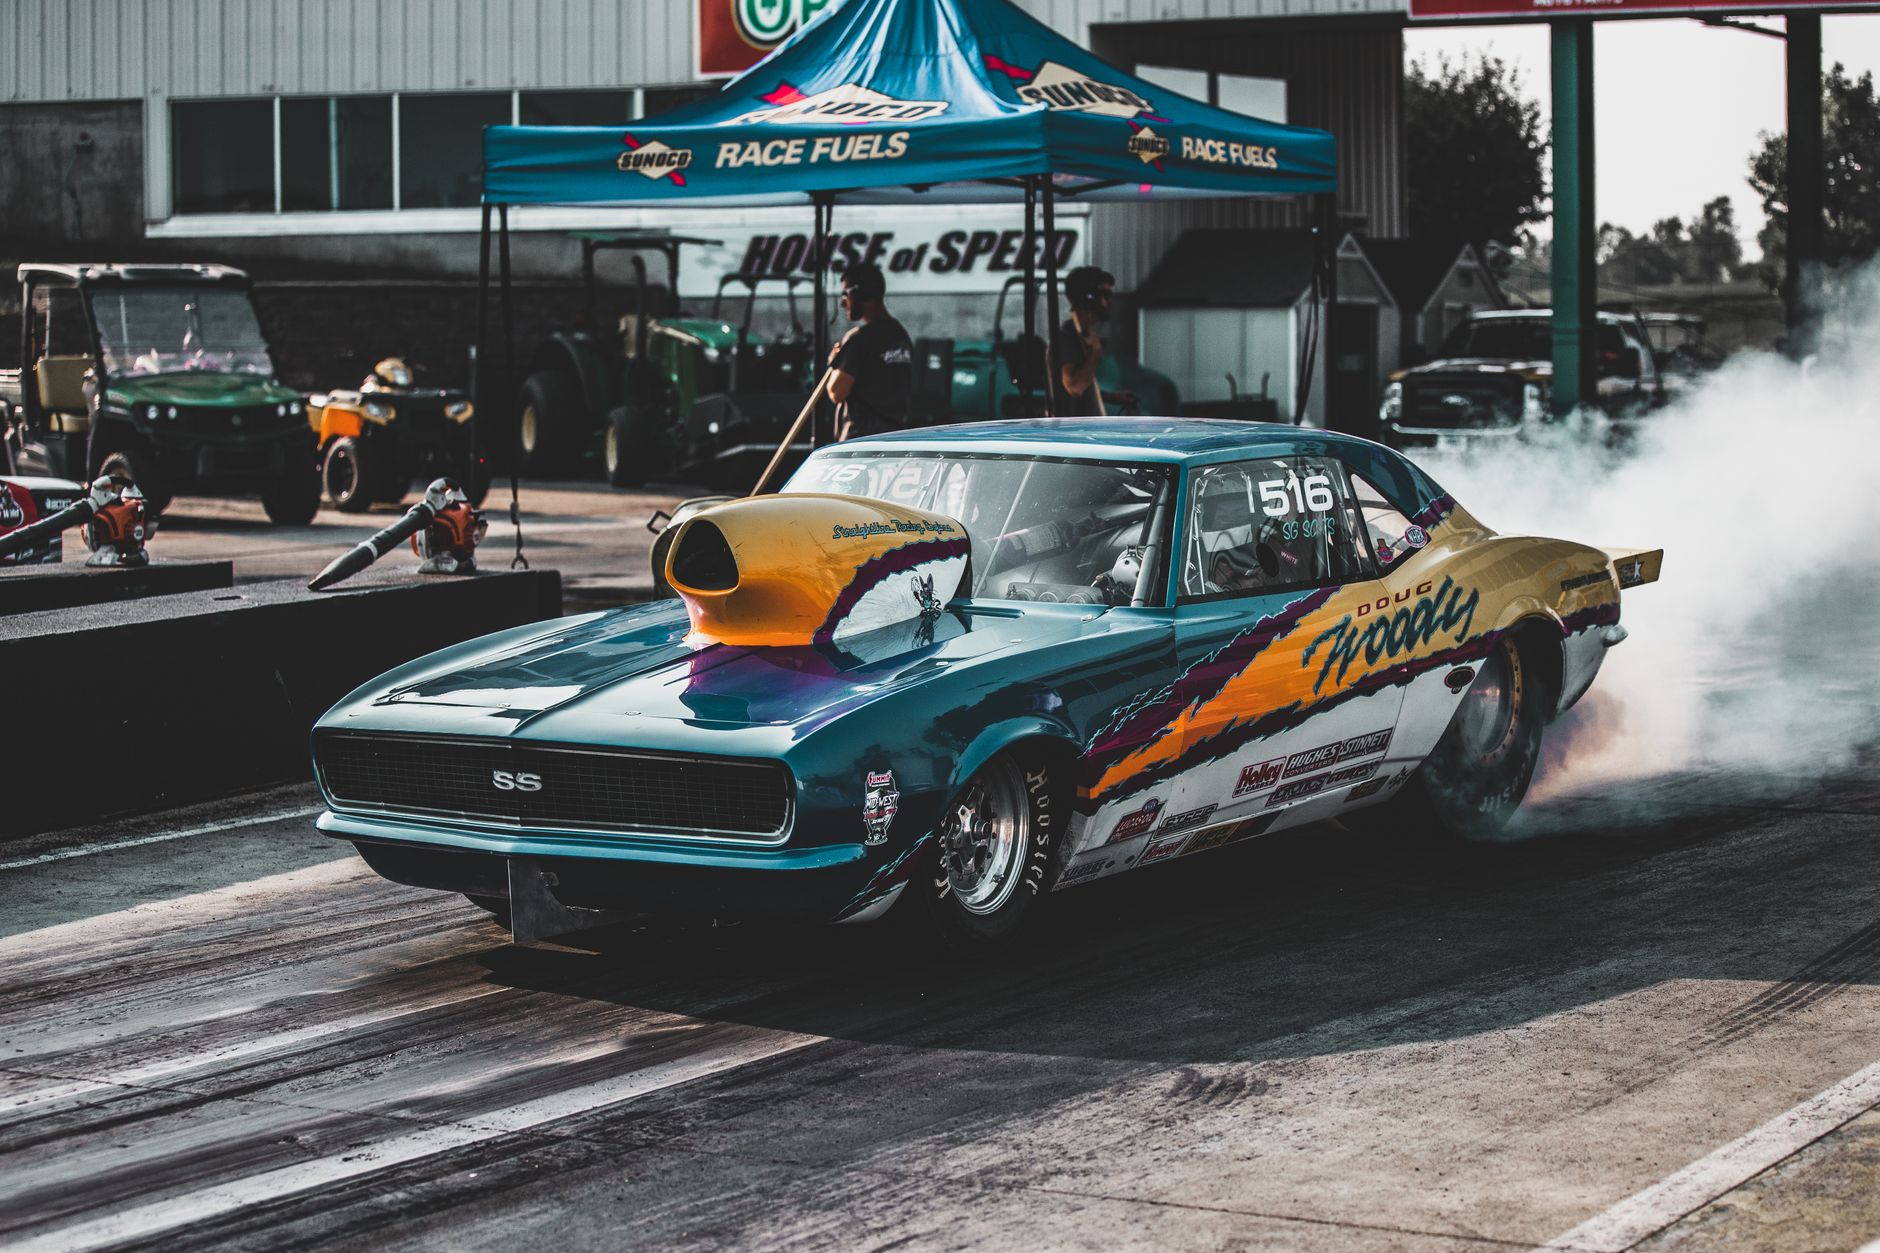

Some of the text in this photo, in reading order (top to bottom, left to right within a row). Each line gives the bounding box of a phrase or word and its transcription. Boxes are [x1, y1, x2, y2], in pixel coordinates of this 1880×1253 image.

[620, 150, 691, 168] SUNOCO
[715, 132, 910, 169] RACE FUELS
[1131, 137, 1170, 154] SUNOCO
[1181, 136, 1279, 169] RACE FUELS
[739, 232, 893, 273] HOUSE
[928, 230, 1080, 273] SPEED
[1258, 471, 1333, 516] 516
[1357, 580, 1433, 618] DOUG
[1302, 574, 1481, 697] Woody
[1284, 758, 1334, 777] CONVERTERS
[1288, 743, 1341, 769] HUGHES
[492, 770, 543, 792] SS
[1237, 761, 1284, 790] Holley
[865, 794, 898, 809] MID-WEST
